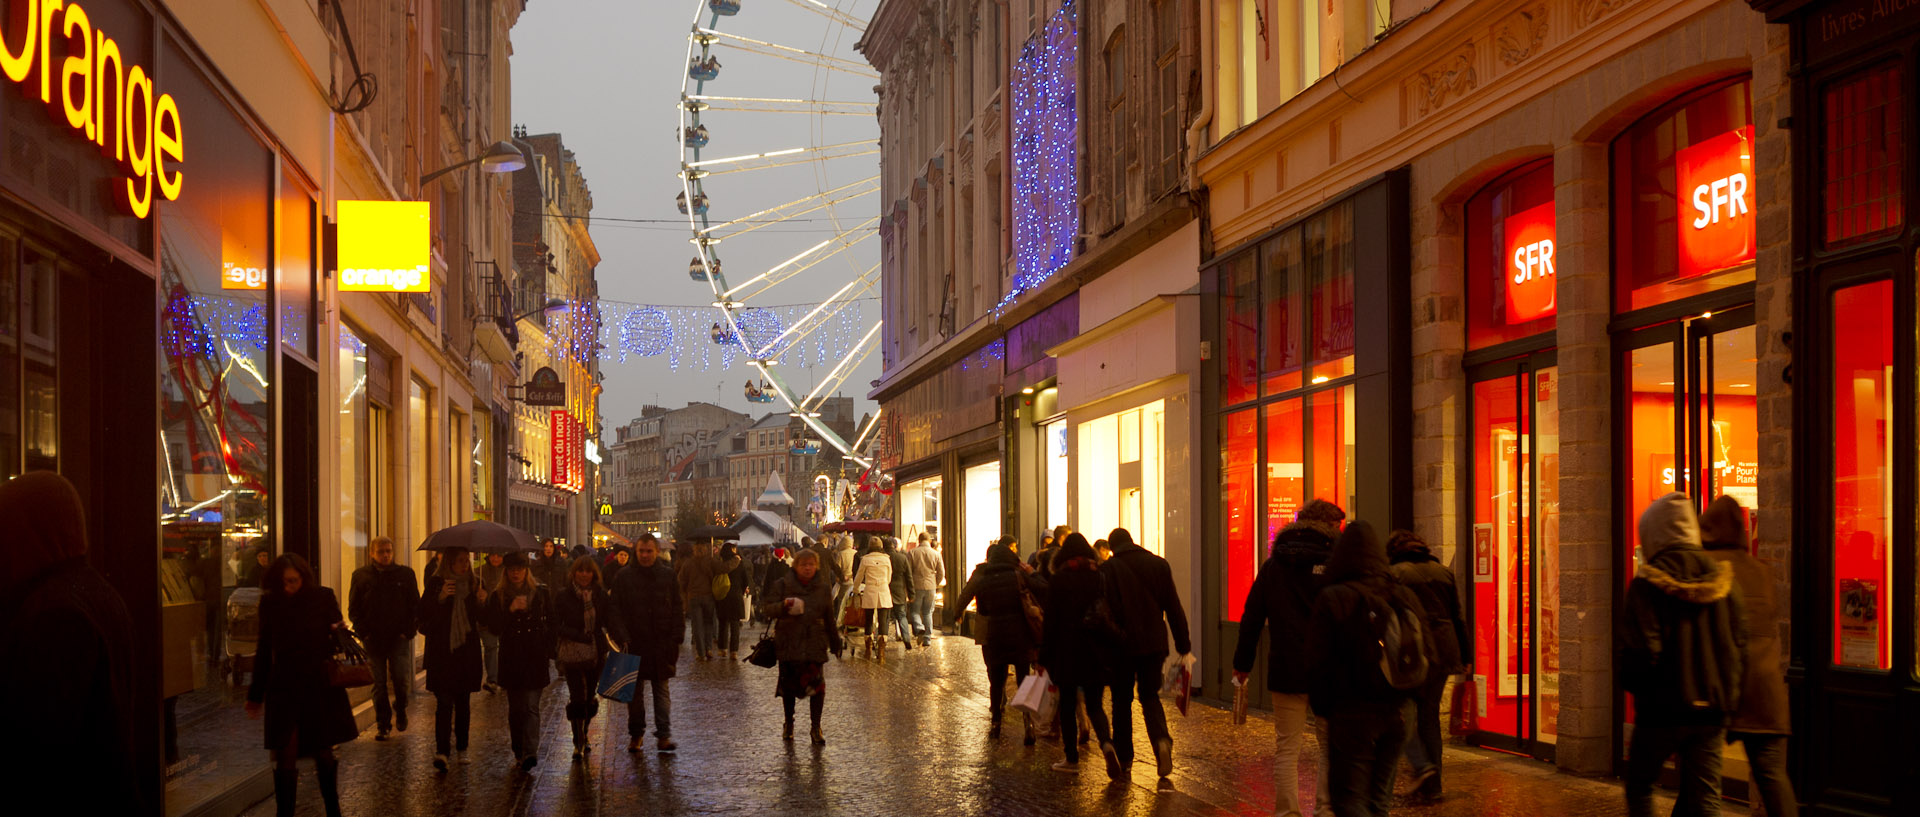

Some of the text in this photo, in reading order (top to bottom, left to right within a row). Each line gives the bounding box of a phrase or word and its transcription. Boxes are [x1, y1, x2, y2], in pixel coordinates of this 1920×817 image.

[1821, 0, 1919, 41] Livres Anc
[0, 0, 183, 219] orange
[1693, 172, 1748, 229] SFR
[341, 268, 421, 290] orange
[1514, 239, 1554, 284] SFR
[554, 413, 564, 482] Furet du nord
[1507, 446, 1517, 454] SF
[1736, 467, 1753, 475] Pour
[1736, 475, 1757, 483] Planè
